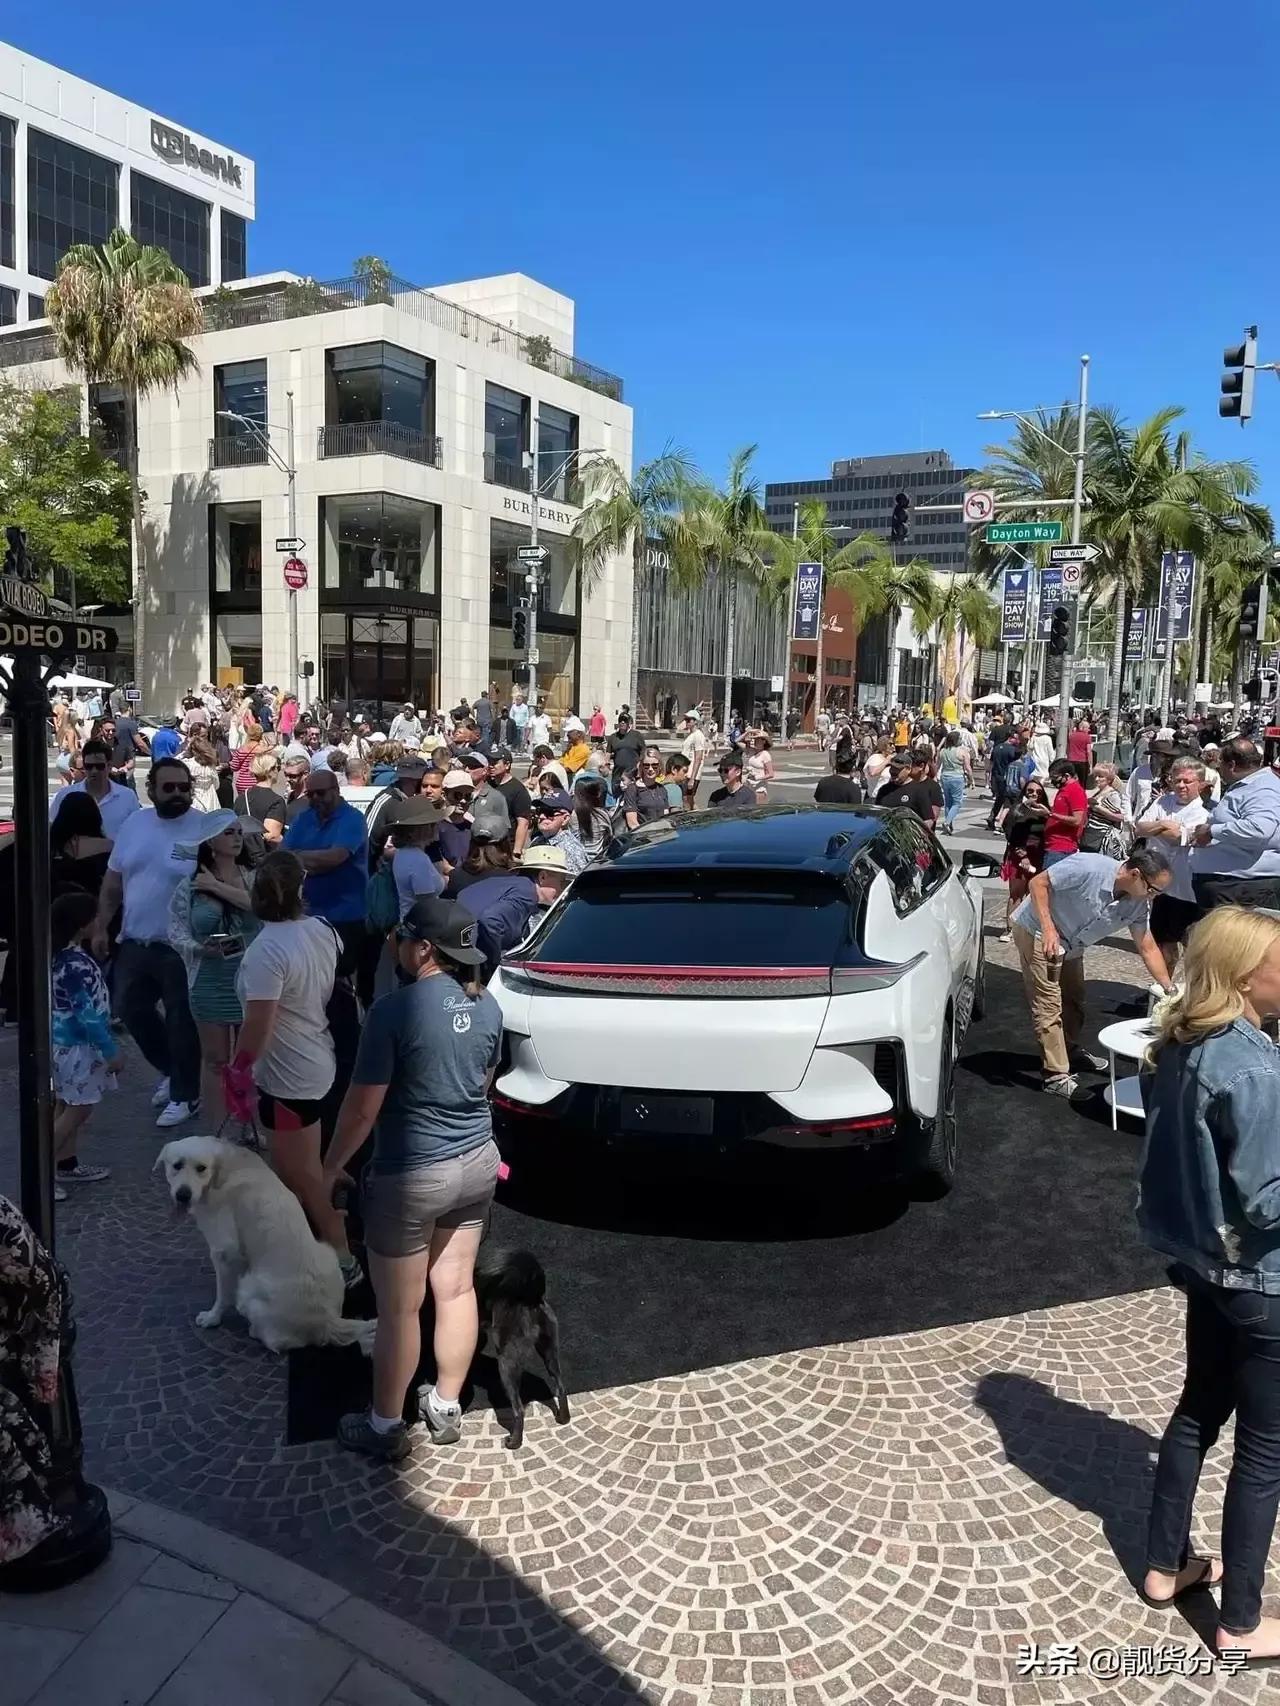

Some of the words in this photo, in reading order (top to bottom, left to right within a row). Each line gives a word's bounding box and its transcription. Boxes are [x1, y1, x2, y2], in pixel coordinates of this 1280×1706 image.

[503, 497, 572, 524] BURERRY
[992, 529, 1030, 541] Dayton
[1034, 527, 1056, 539] Way
[800, 581, 818, 591] DAY
[5, 580, 21, 606] VIA
[22, 583, 45, 616] RODEO
[1004, 605, 1025, 615] DAY
[1004, 621, 1024, 629] SHOW
[76, 627, 106, 649] DR
